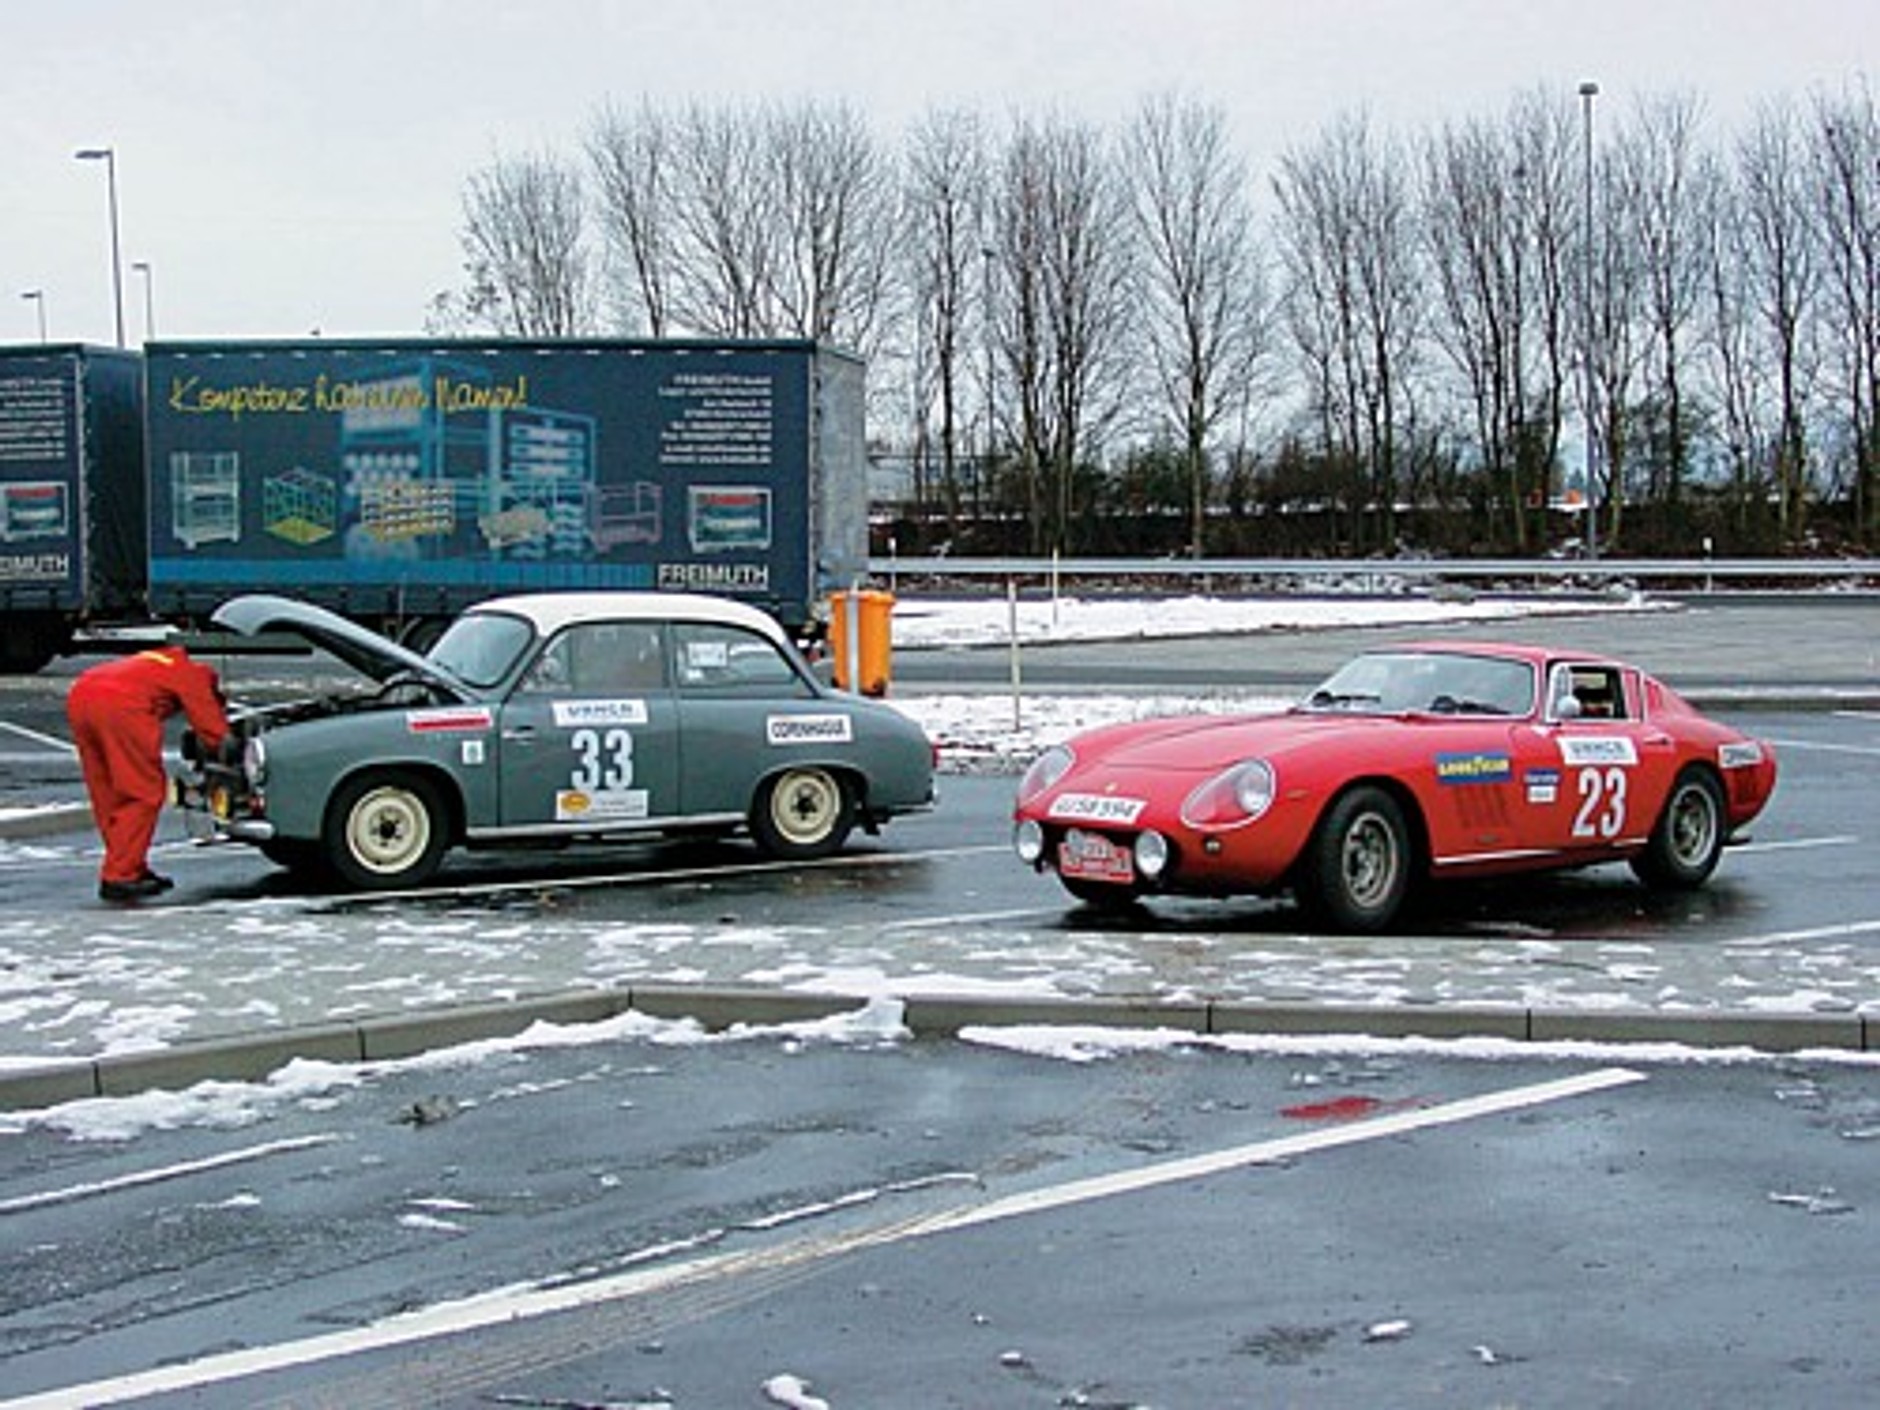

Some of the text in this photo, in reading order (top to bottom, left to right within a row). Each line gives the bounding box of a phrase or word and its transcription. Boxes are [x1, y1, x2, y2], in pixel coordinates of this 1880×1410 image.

[659, 563, 769, 589] FREIMUTH
[571, 729, 633, 791] 33
[1572, 767, 1626, 837] 23
